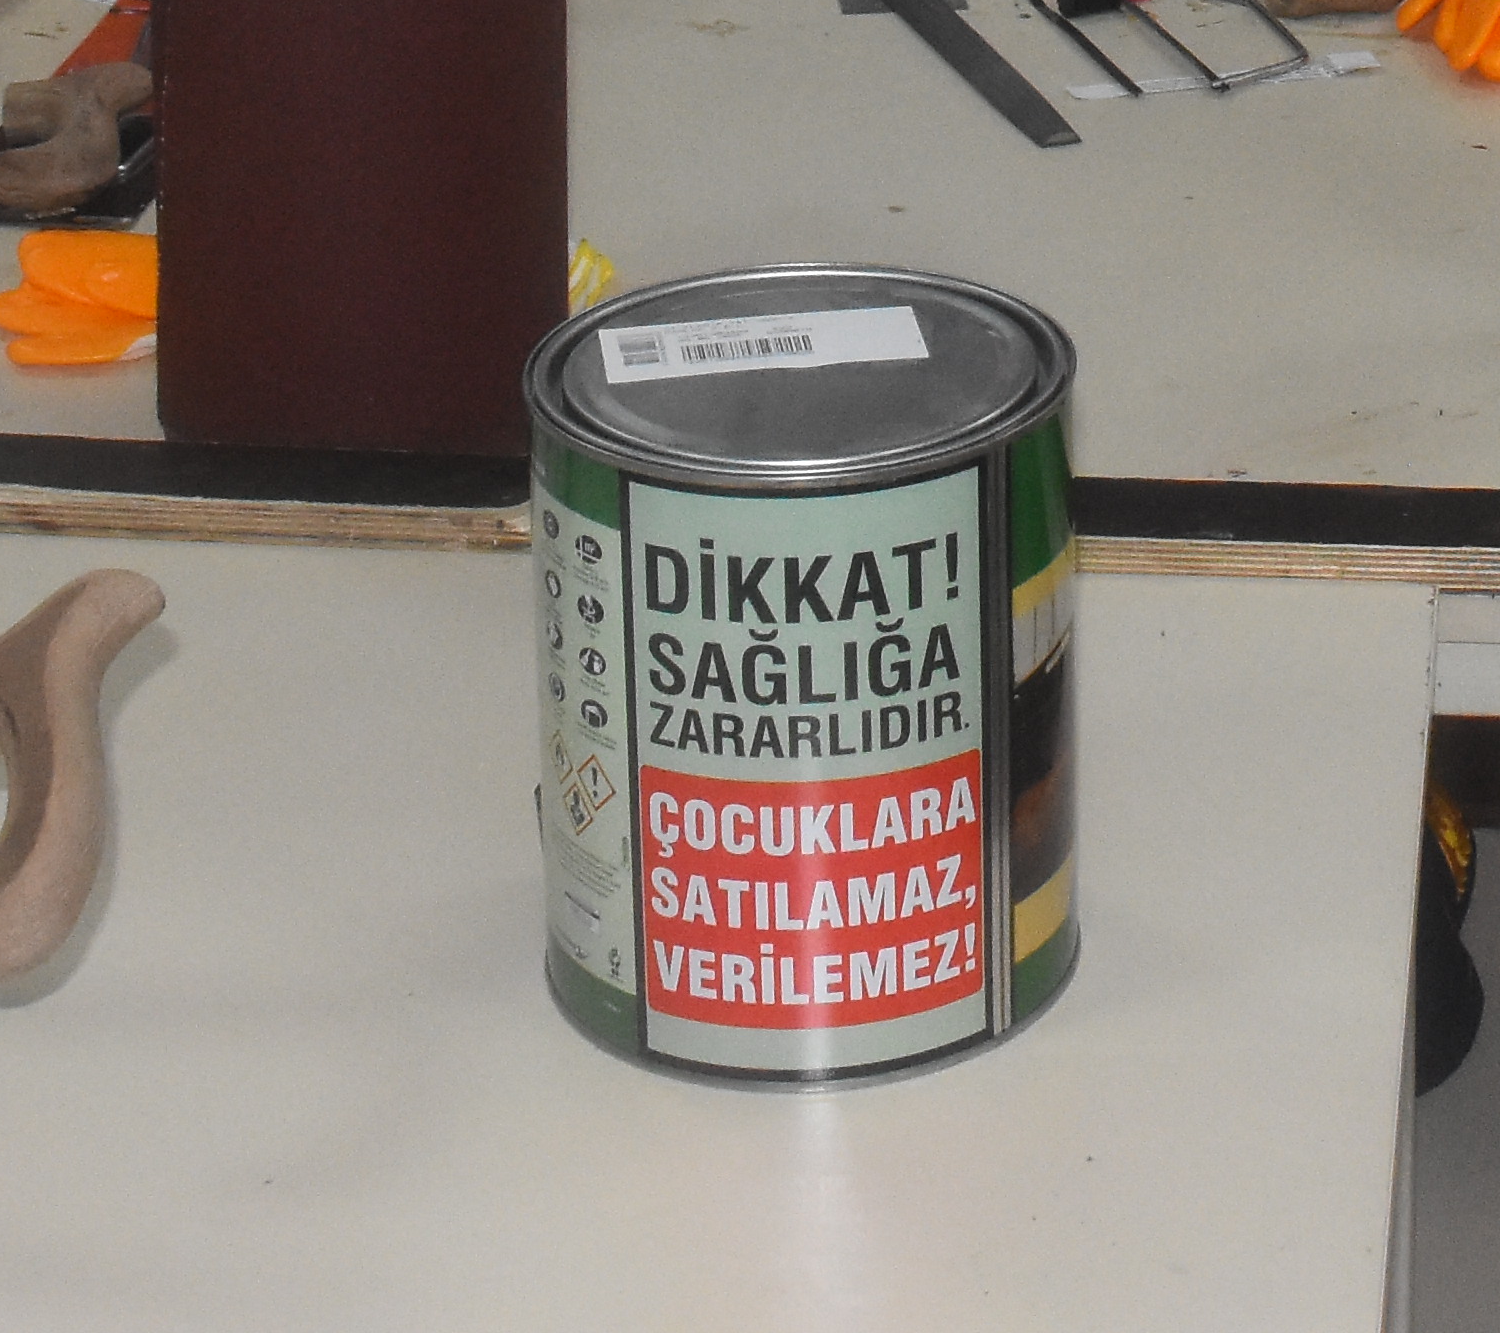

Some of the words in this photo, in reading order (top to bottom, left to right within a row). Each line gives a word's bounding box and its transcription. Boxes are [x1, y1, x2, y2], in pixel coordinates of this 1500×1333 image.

[644, 531, 959, 624] DİKKAT!
[648, 617, 961, 706] SAĞLIĞA
[649, 690, 970, 759] ZARARLIDIR.
[648, 776, 977, 859] ÇOCUKLARA
[650, 853, 977, 933] SATILAMAZ,
[652, 921, 977, 1006] VERİLEMEZ!
